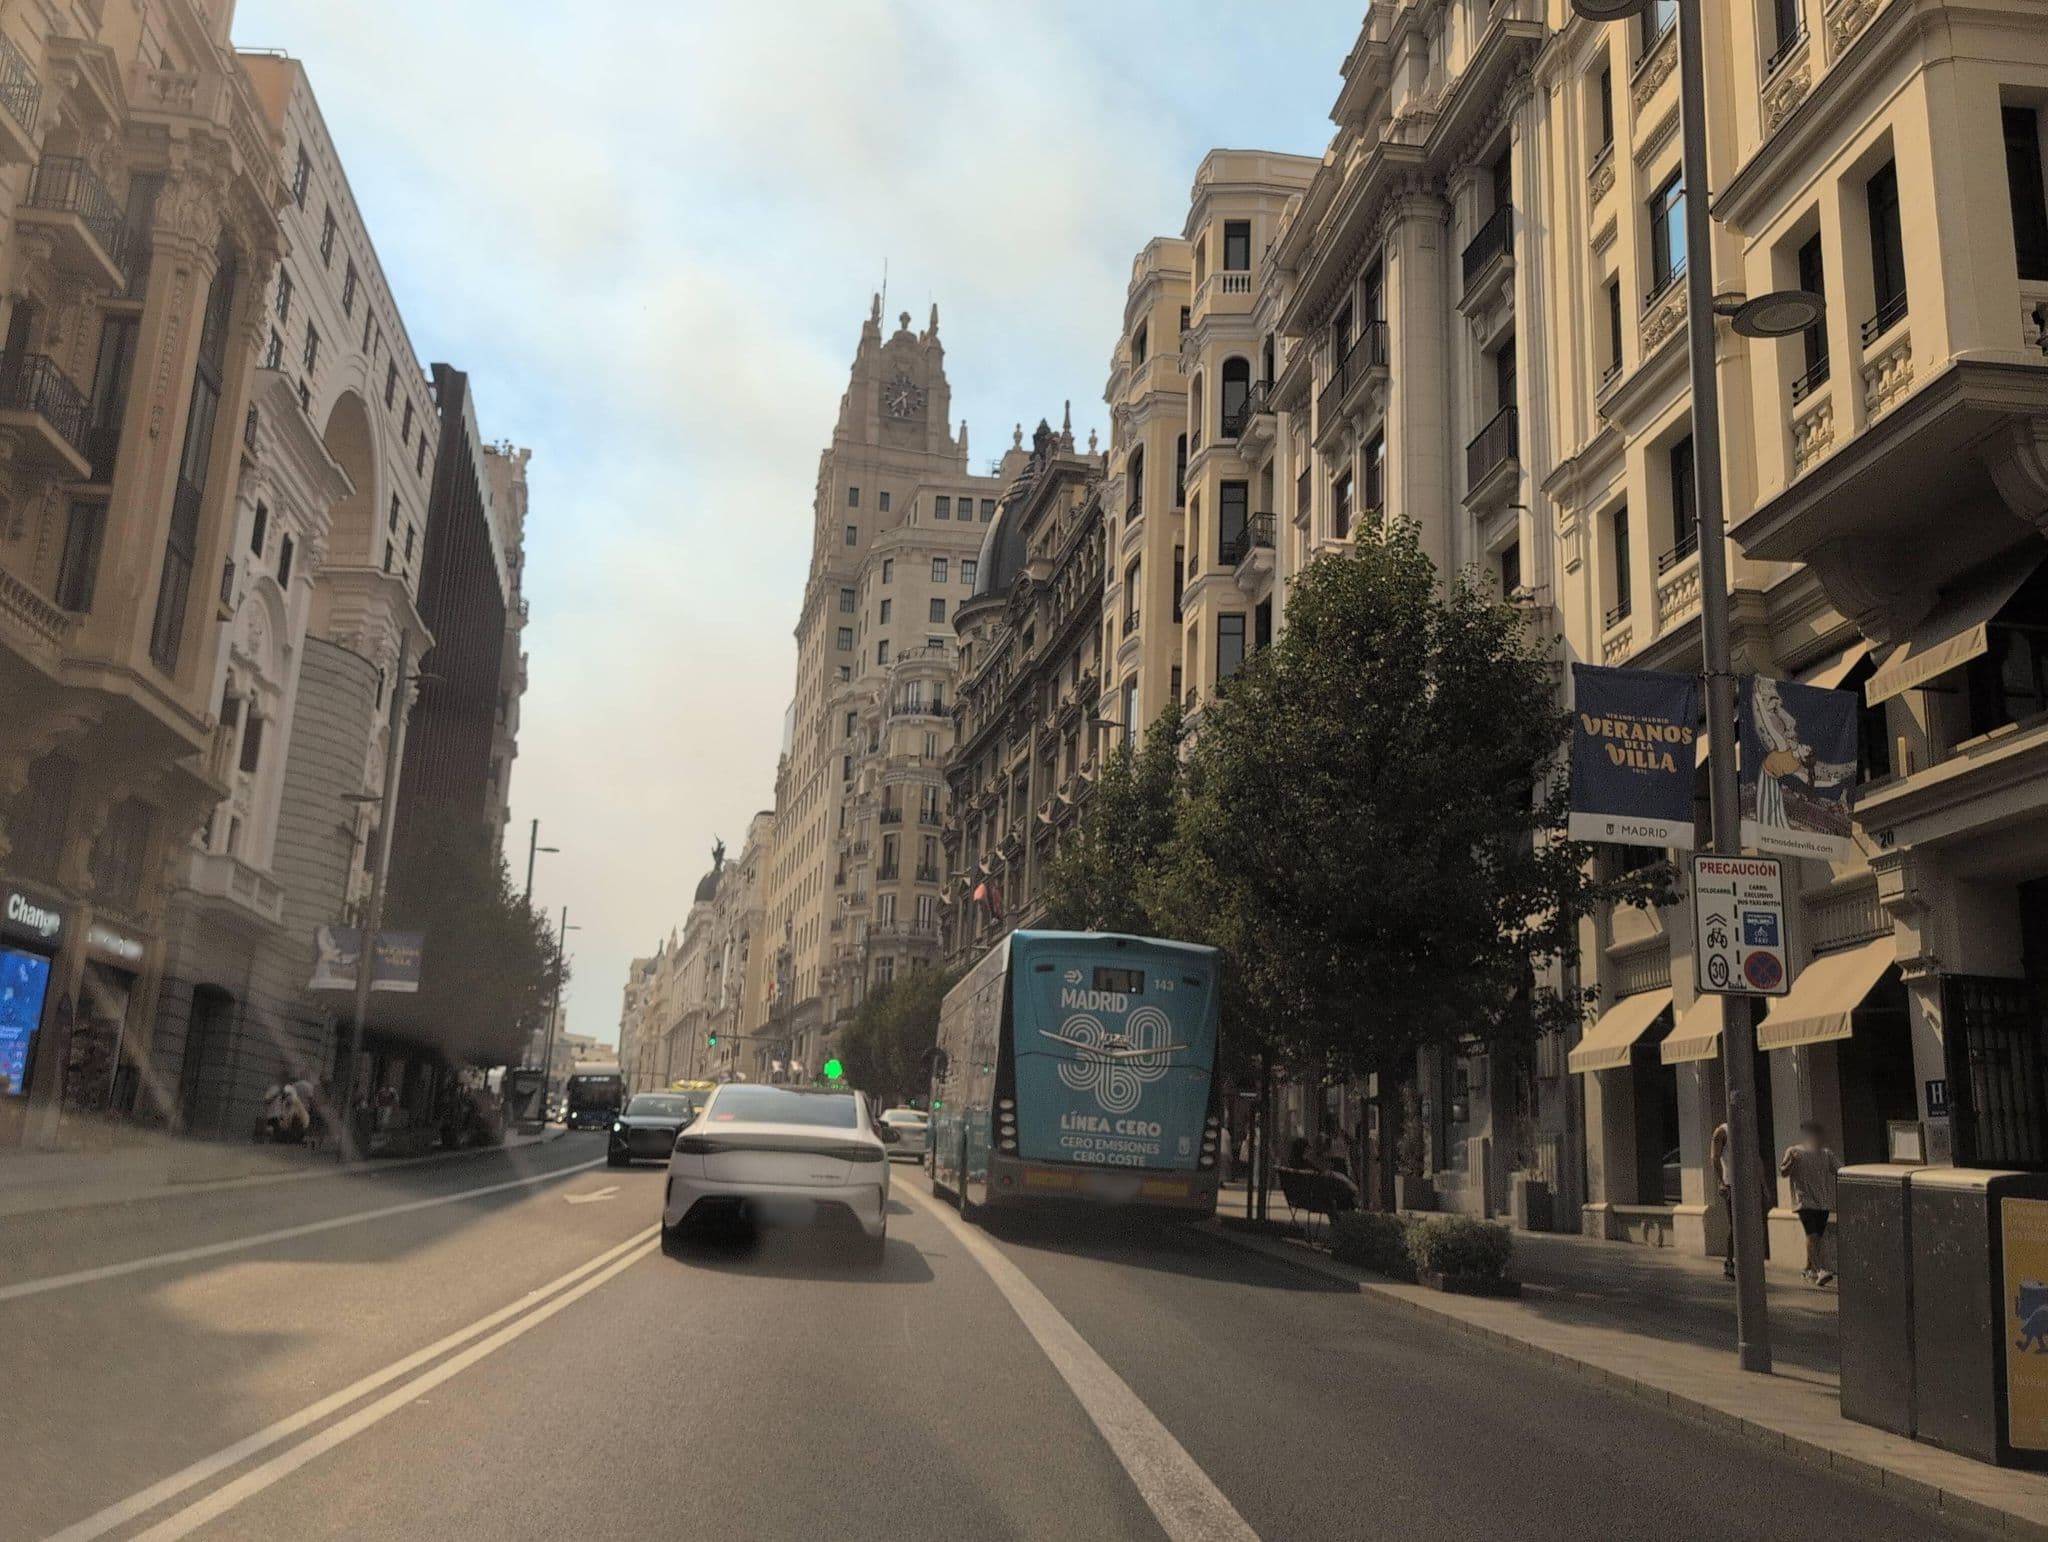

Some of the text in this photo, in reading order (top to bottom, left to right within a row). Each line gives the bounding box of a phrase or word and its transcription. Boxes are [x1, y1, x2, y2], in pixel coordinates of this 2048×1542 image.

[1581, 713, 1693, 745] VERANOS
[1624, 740, 1653, 750] DE LA
[1605, 742, 1677, 773] VILLA
[1621, 825, 1667, 839] MADRID
[1700, 862, 1776, 876] PRECAUCIÓN
[1712, 962, 1725, 979] 30
[1061, 988, 1128, 1013] MADRID
[1931, 1083, 1944, 1104] H
[1061, 1111, 1161, 1137] LÍNEA CERO
[1060, 1136, 1160, 1154] CERO EMISIONES
[1073, 1150, 1145, 1167] CERO COSTE
